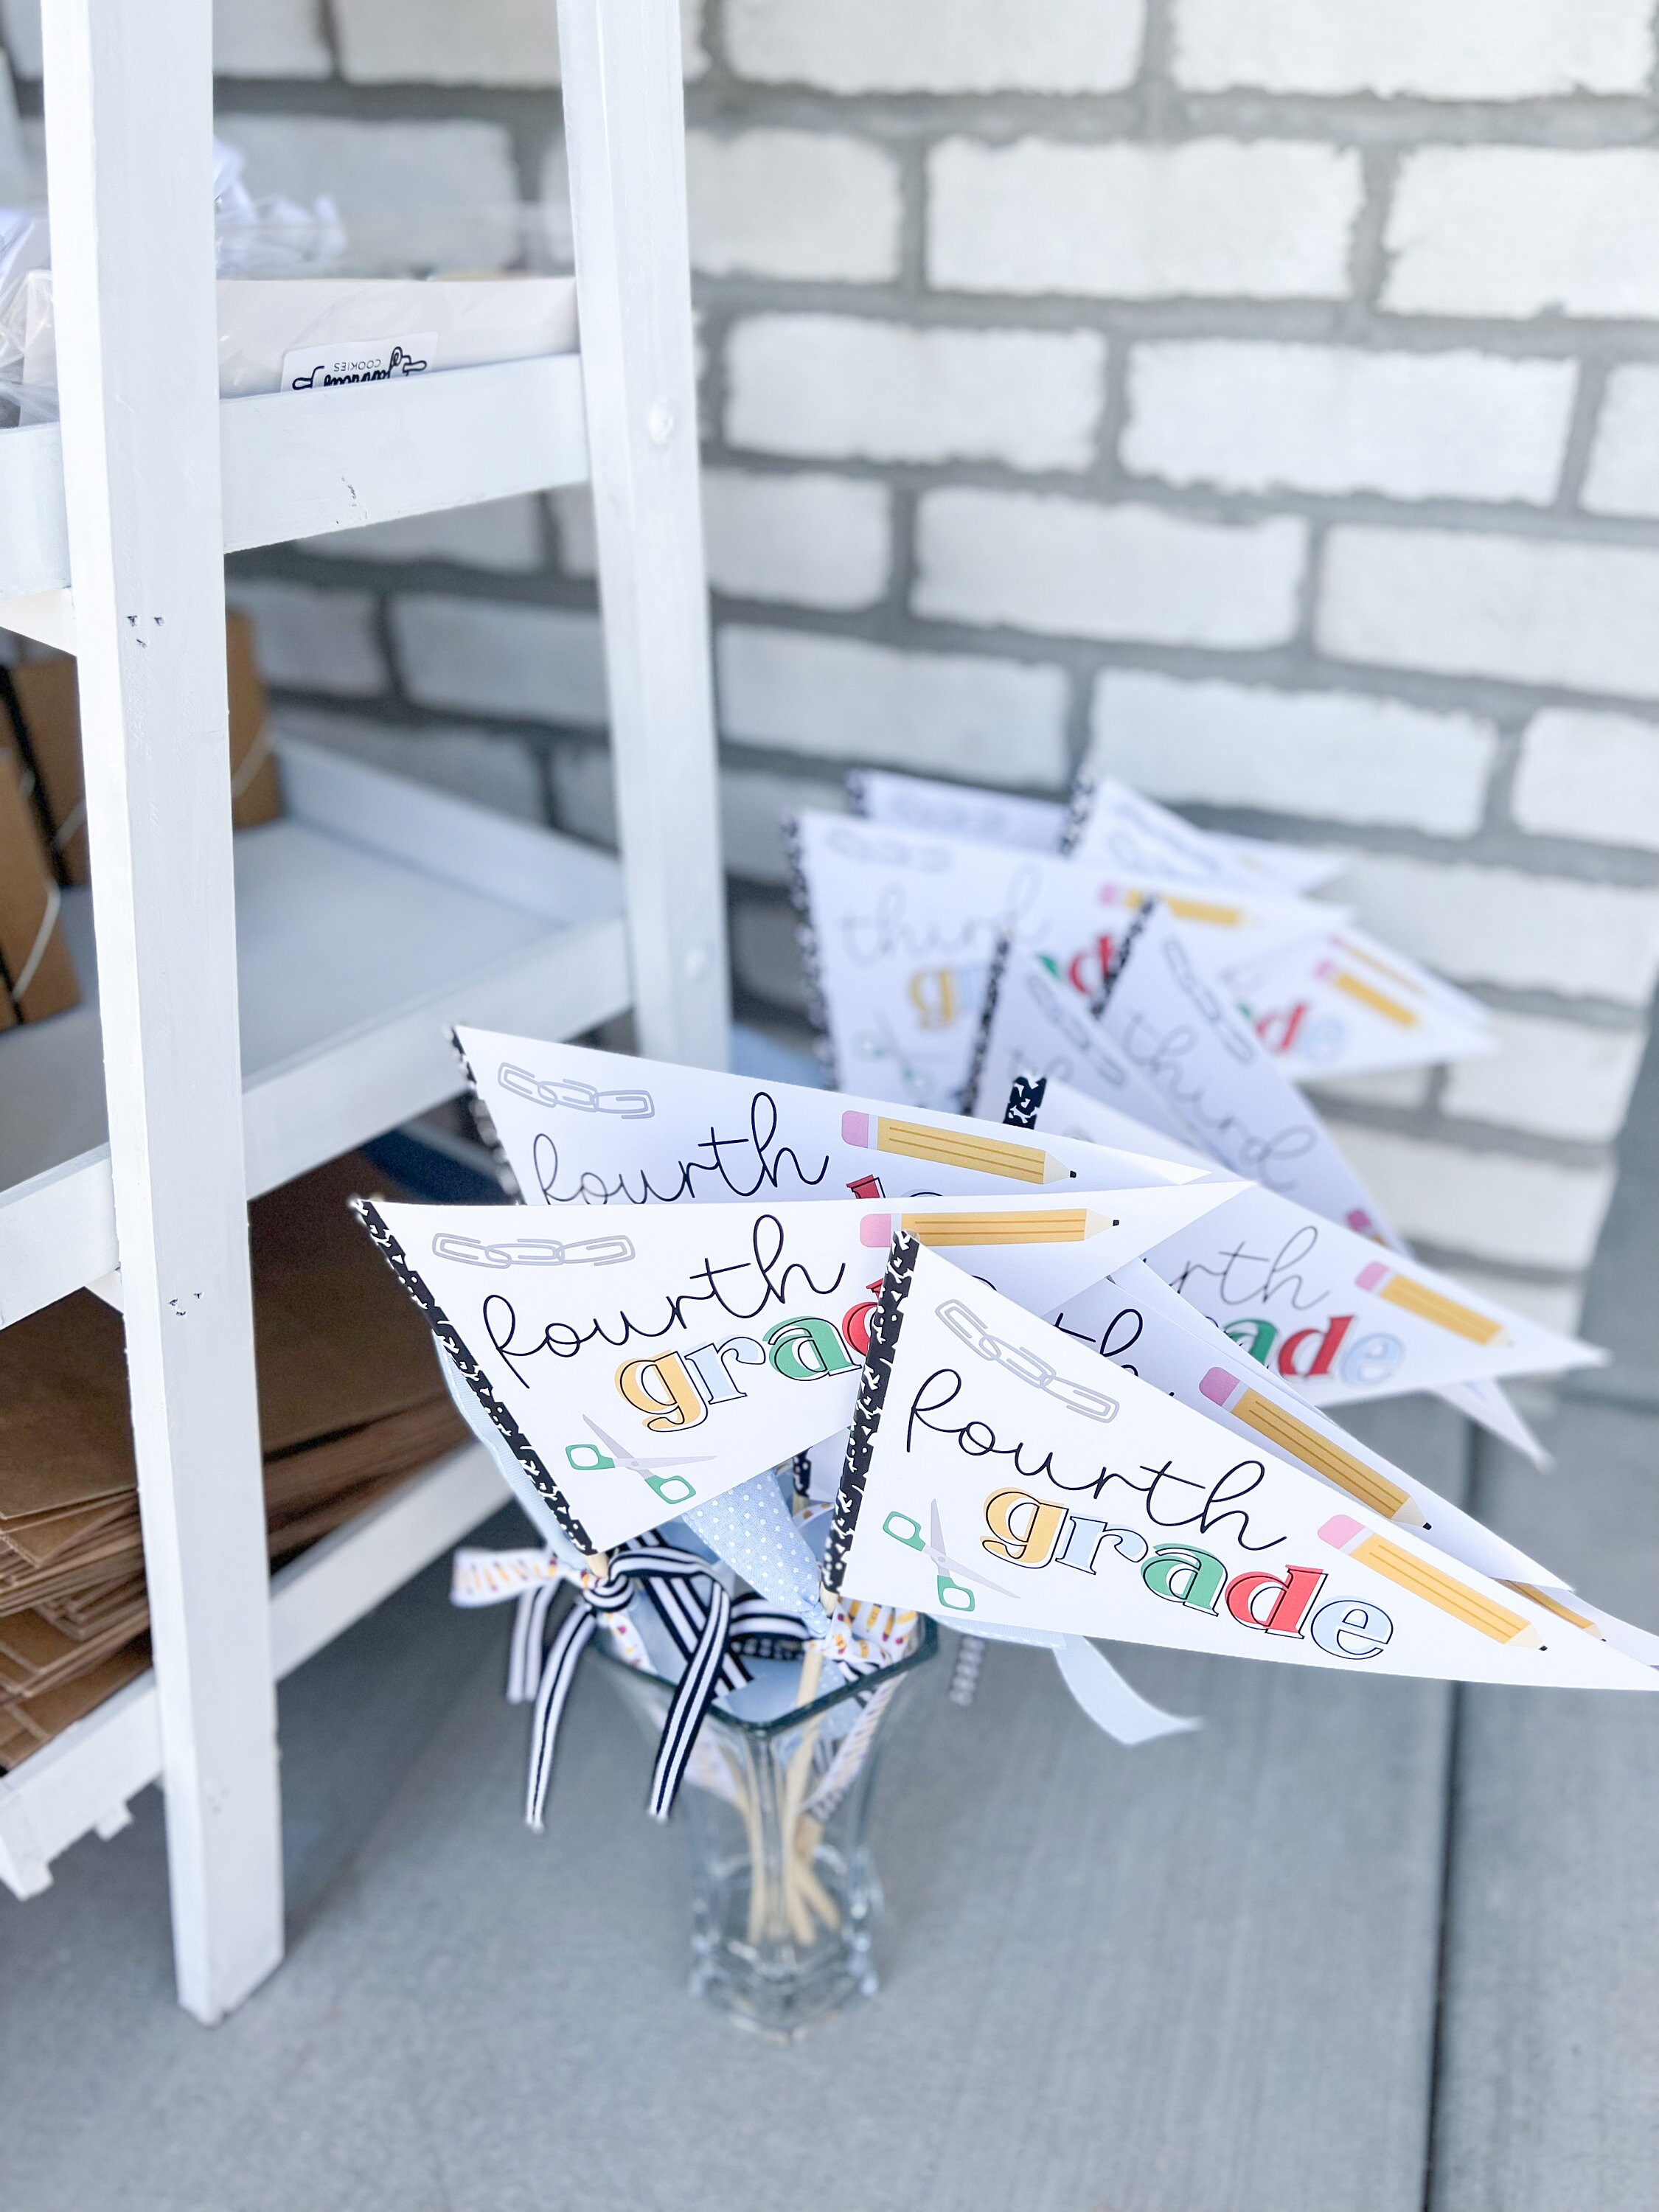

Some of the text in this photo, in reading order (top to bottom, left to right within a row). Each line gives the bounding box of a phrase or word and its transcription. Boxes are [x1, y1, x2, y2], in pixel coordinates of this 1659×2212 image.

[335, 358, 381, 372] COOKIES
[483, 1214, 846, 1388] fourth
[614, 1278, 885, 1432] gra
[906, 1368, 1287, 1551] fourth
[979, 1486, 1394, 1660] grade
